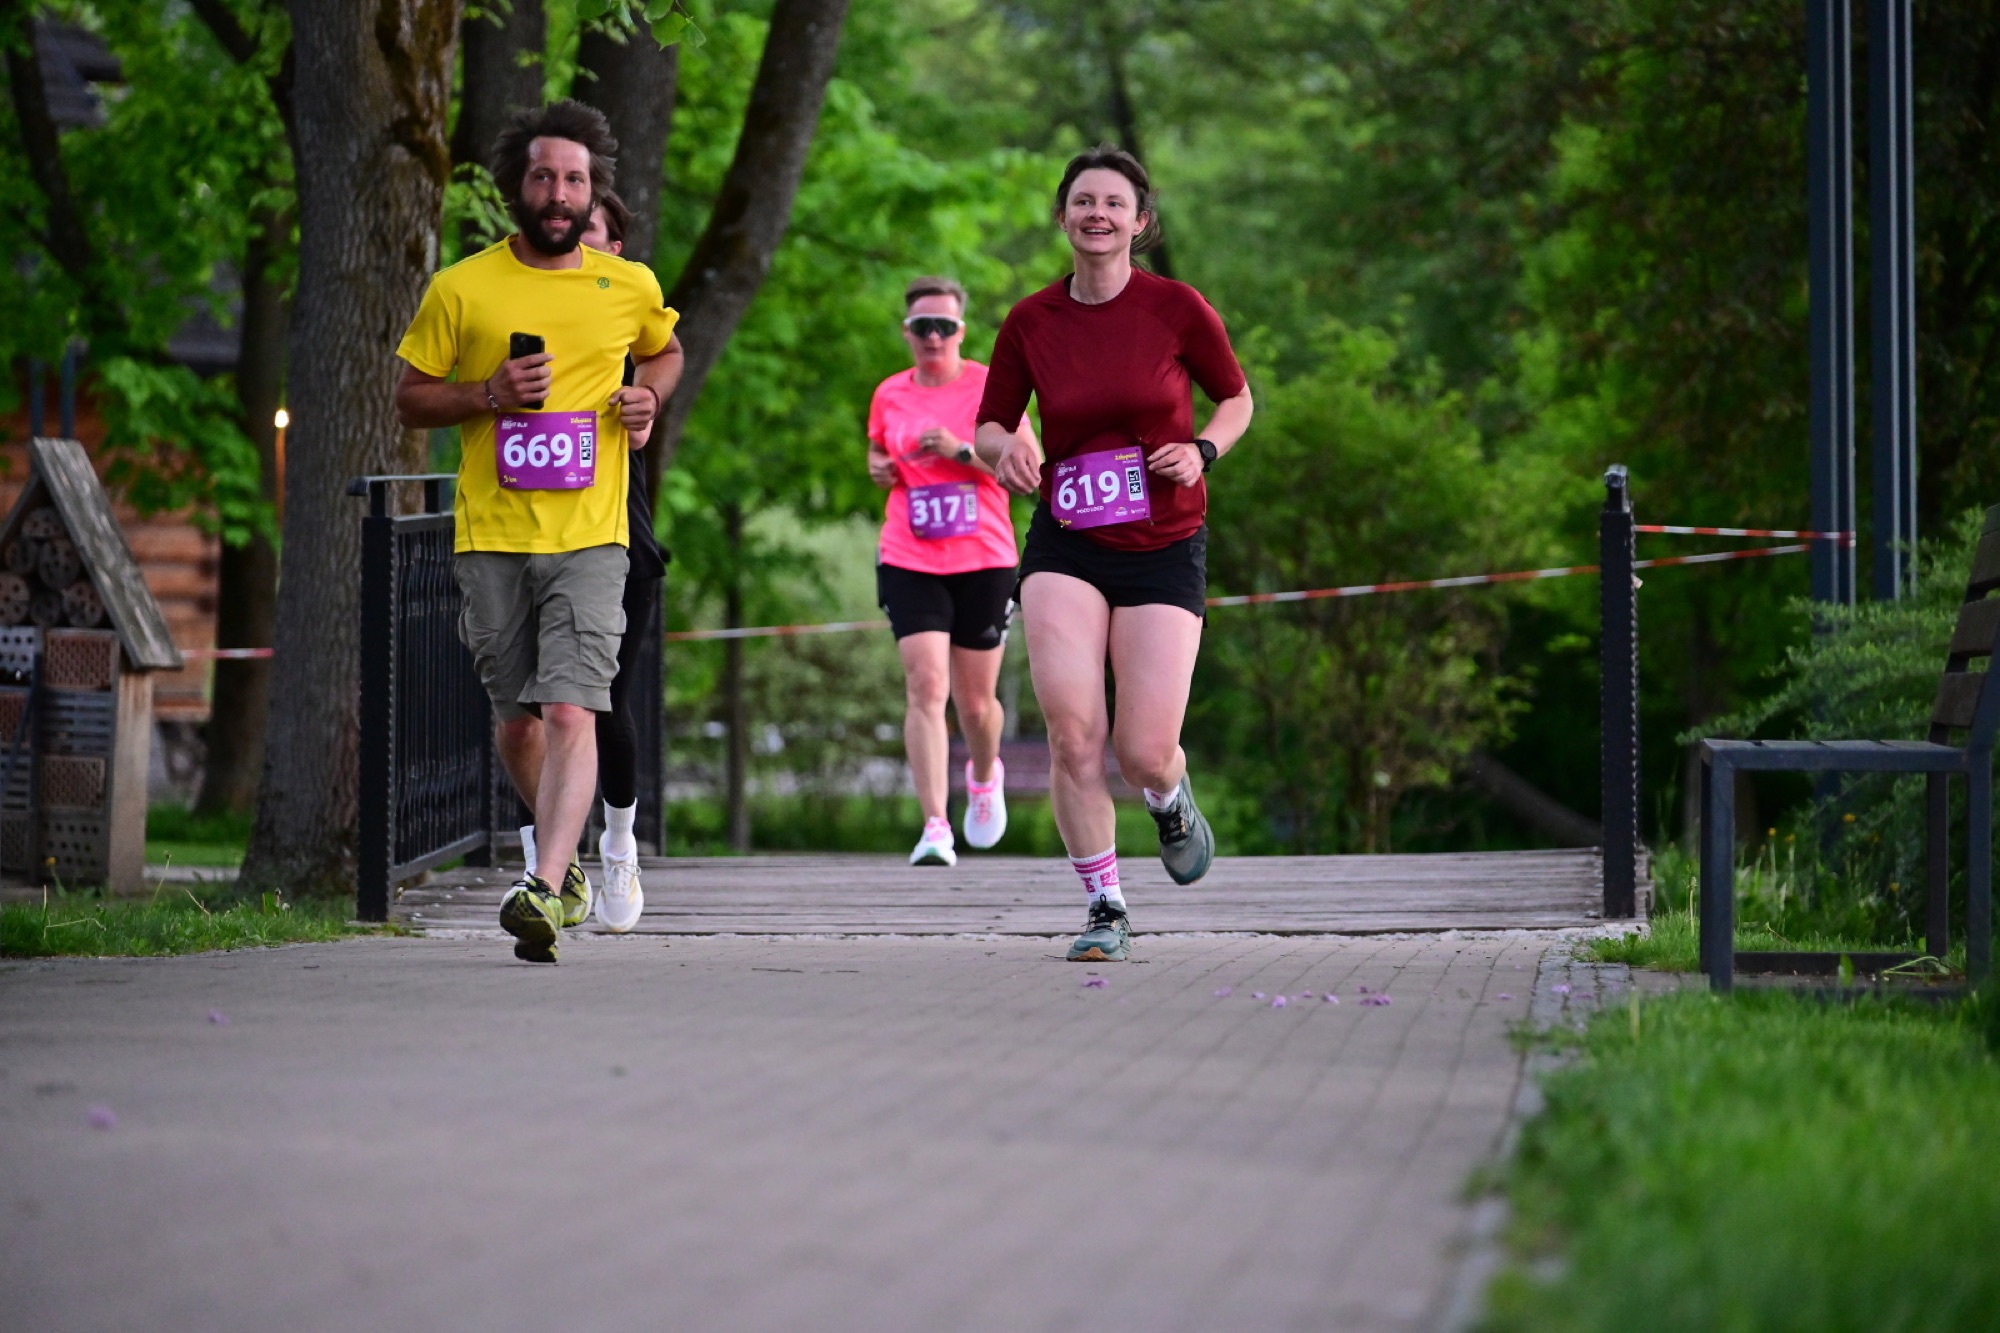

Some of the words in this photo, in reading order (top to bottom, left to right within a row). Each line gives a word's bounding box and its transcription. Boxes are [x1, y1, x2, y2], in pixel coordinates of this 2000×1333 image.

[503, 432, 573, 468] 669
[1058, 470, 1120, 510] 619
[911, 495, 961, 526] 317
